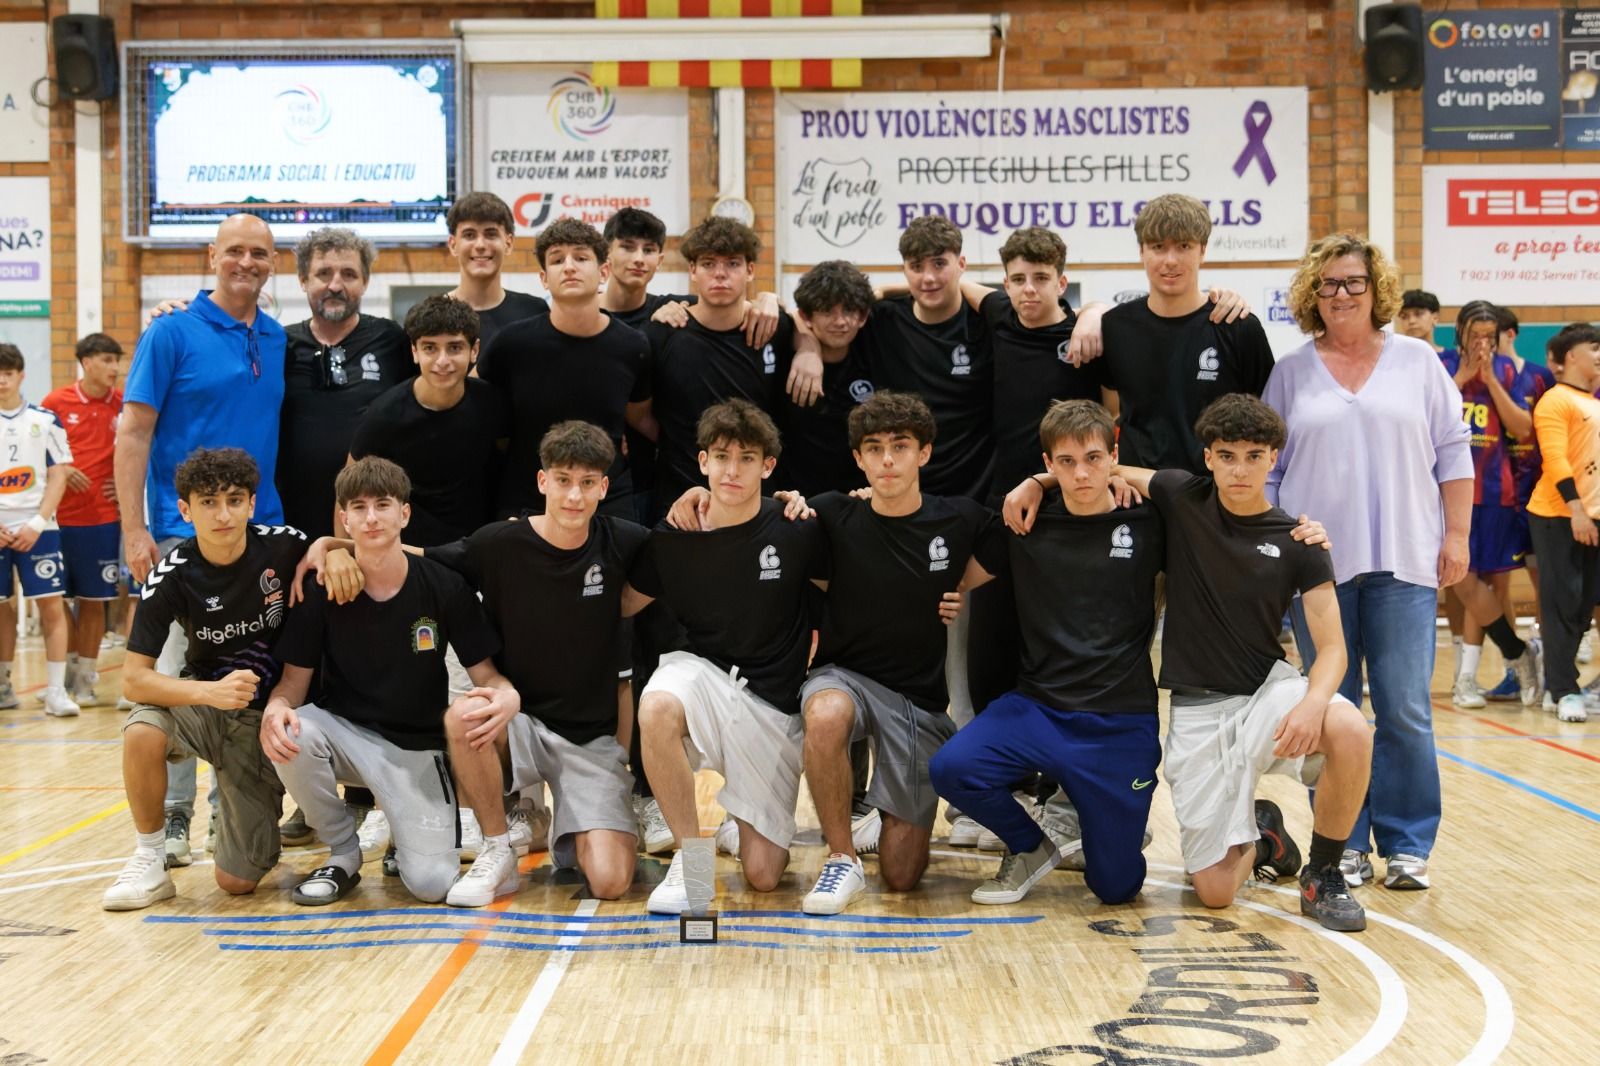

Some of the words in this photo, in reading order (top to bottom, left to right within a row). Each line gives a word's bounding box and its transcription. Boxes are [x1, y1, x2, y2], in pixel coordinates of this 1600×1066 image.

[566, 91, 595, 104] CHB
[1487, 88, 1546, 111] poble
[567, 106, 597, 119] 360
[800, 110, 868, 138] PROU
[875, 100, 1027, 138] VIOLÈNCIES
[1033, 106, 1190, 136] MASCLISTES
[491, 150, 556, 163] CREIXEM
[562, 149, 595, 162] AMB
[187, 164, 272, 182] PROGRAMA
[277, 163, 327, 181] SOCIAL
[333, 164, 340, 180] I
[343, 163, 417, 181] EDUCATIU
[497, 167, 569, 180] EDUQUEM
[575, 166, 608, 179] AMB
[614, 166, 669, 179] VALORS
[898, 157, 1038, 184] PROTEGIU
[1048, 156, 1093, 183] LES
[1104, 154, 1190, 182] FILLES
[1459, 190, 1600, 215] TELEC
[834, 199, 885, 238] poble
[897, 201, 1076, 235] EDUQUEU
[1212, 236, 1288, 251] #diversitat
[1495, 242, 1509, 254] a
[1513, 239, 1568, 261] prop
[1462, 402, 1488, 428] 78
[9, 444, 18, 461] 2
[196, 613, 264, 644] dig8ital
